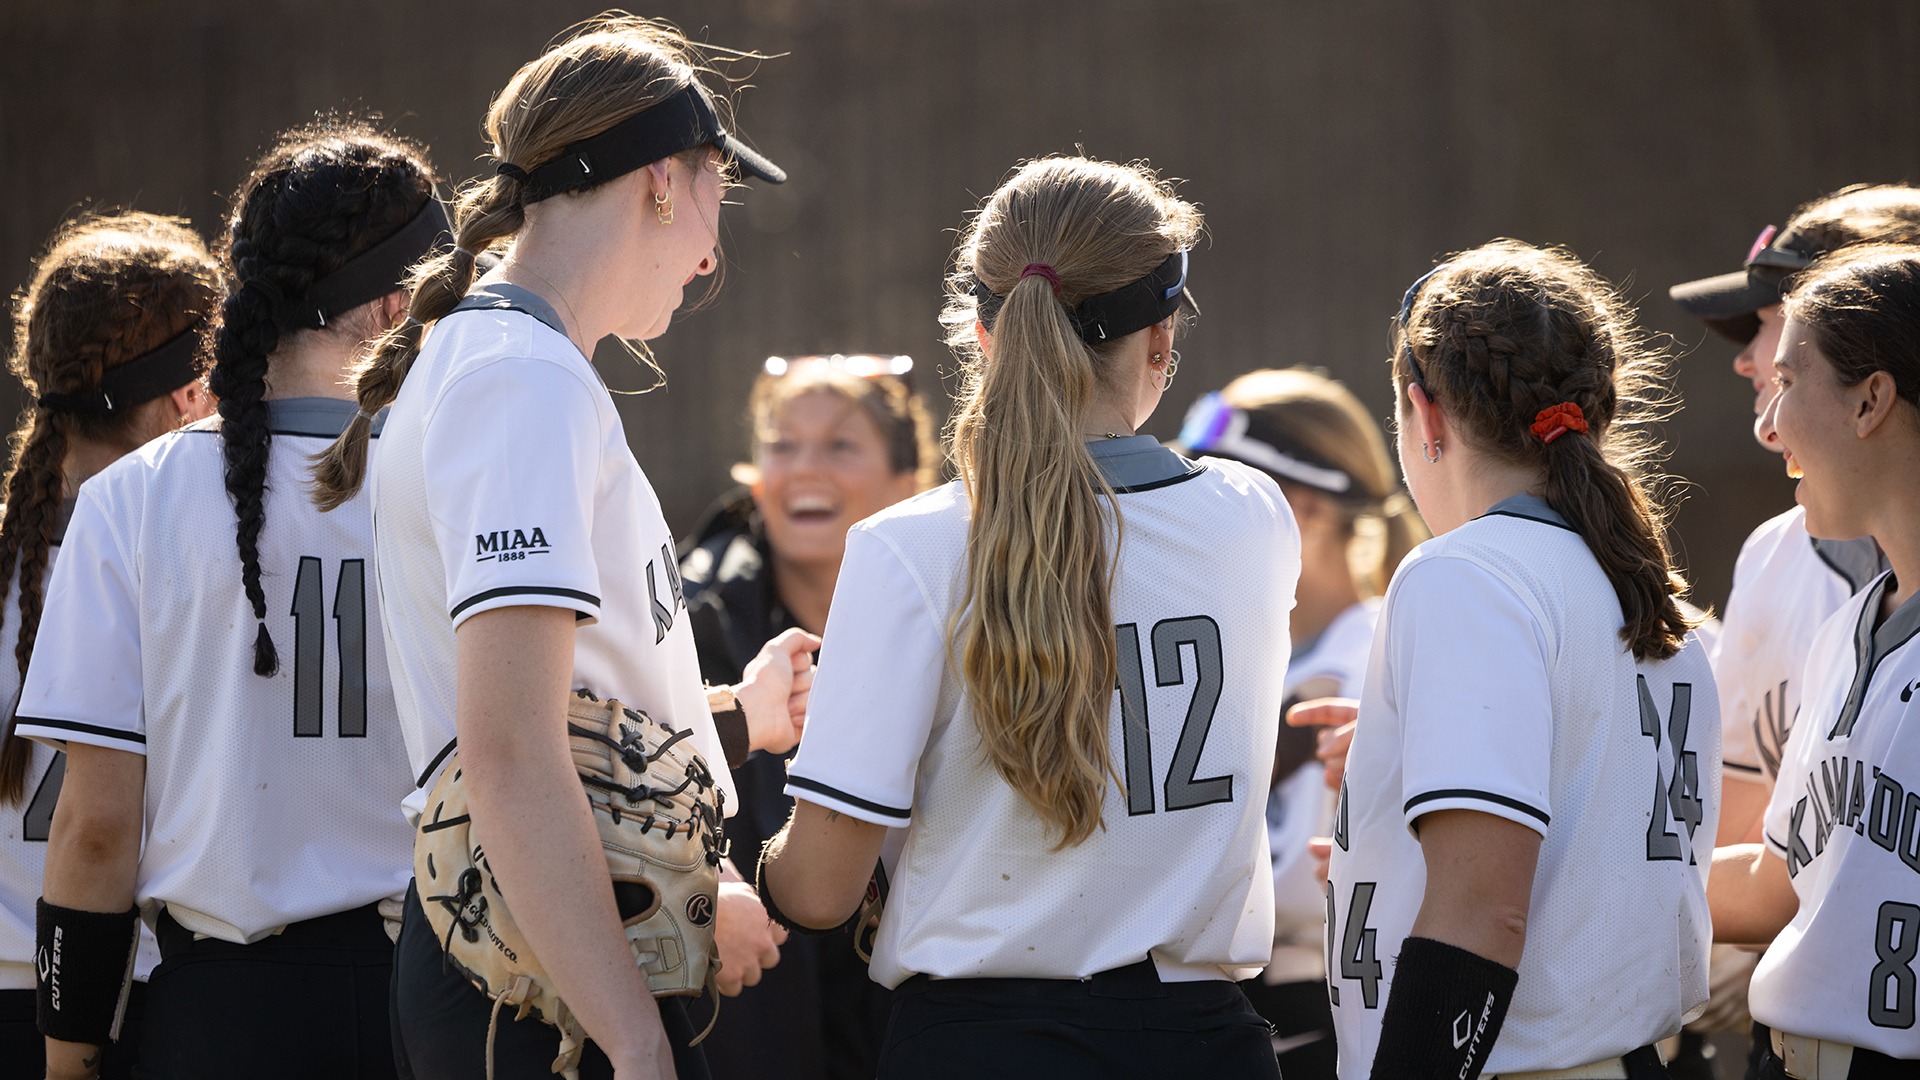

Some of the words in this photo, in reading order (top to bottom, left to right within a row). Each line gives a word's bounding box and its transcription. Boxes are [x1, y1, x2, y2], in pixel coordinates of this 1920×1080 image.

[475, 527, 549, 555] MIAA
[498, 551, 526, 562] 1888
[646, 535, 686, 646] KA
[290, 556, 367, 738] 11
[1115, 614, 1234, 817] 12
[1787, 756, 1920, 880] KALAMAOO
[52, 925, 63, 1012] CUTTERS
[1868, 900, 1920, 1029] 8
[1458, 991, 1495, 1080] CUTTERS
